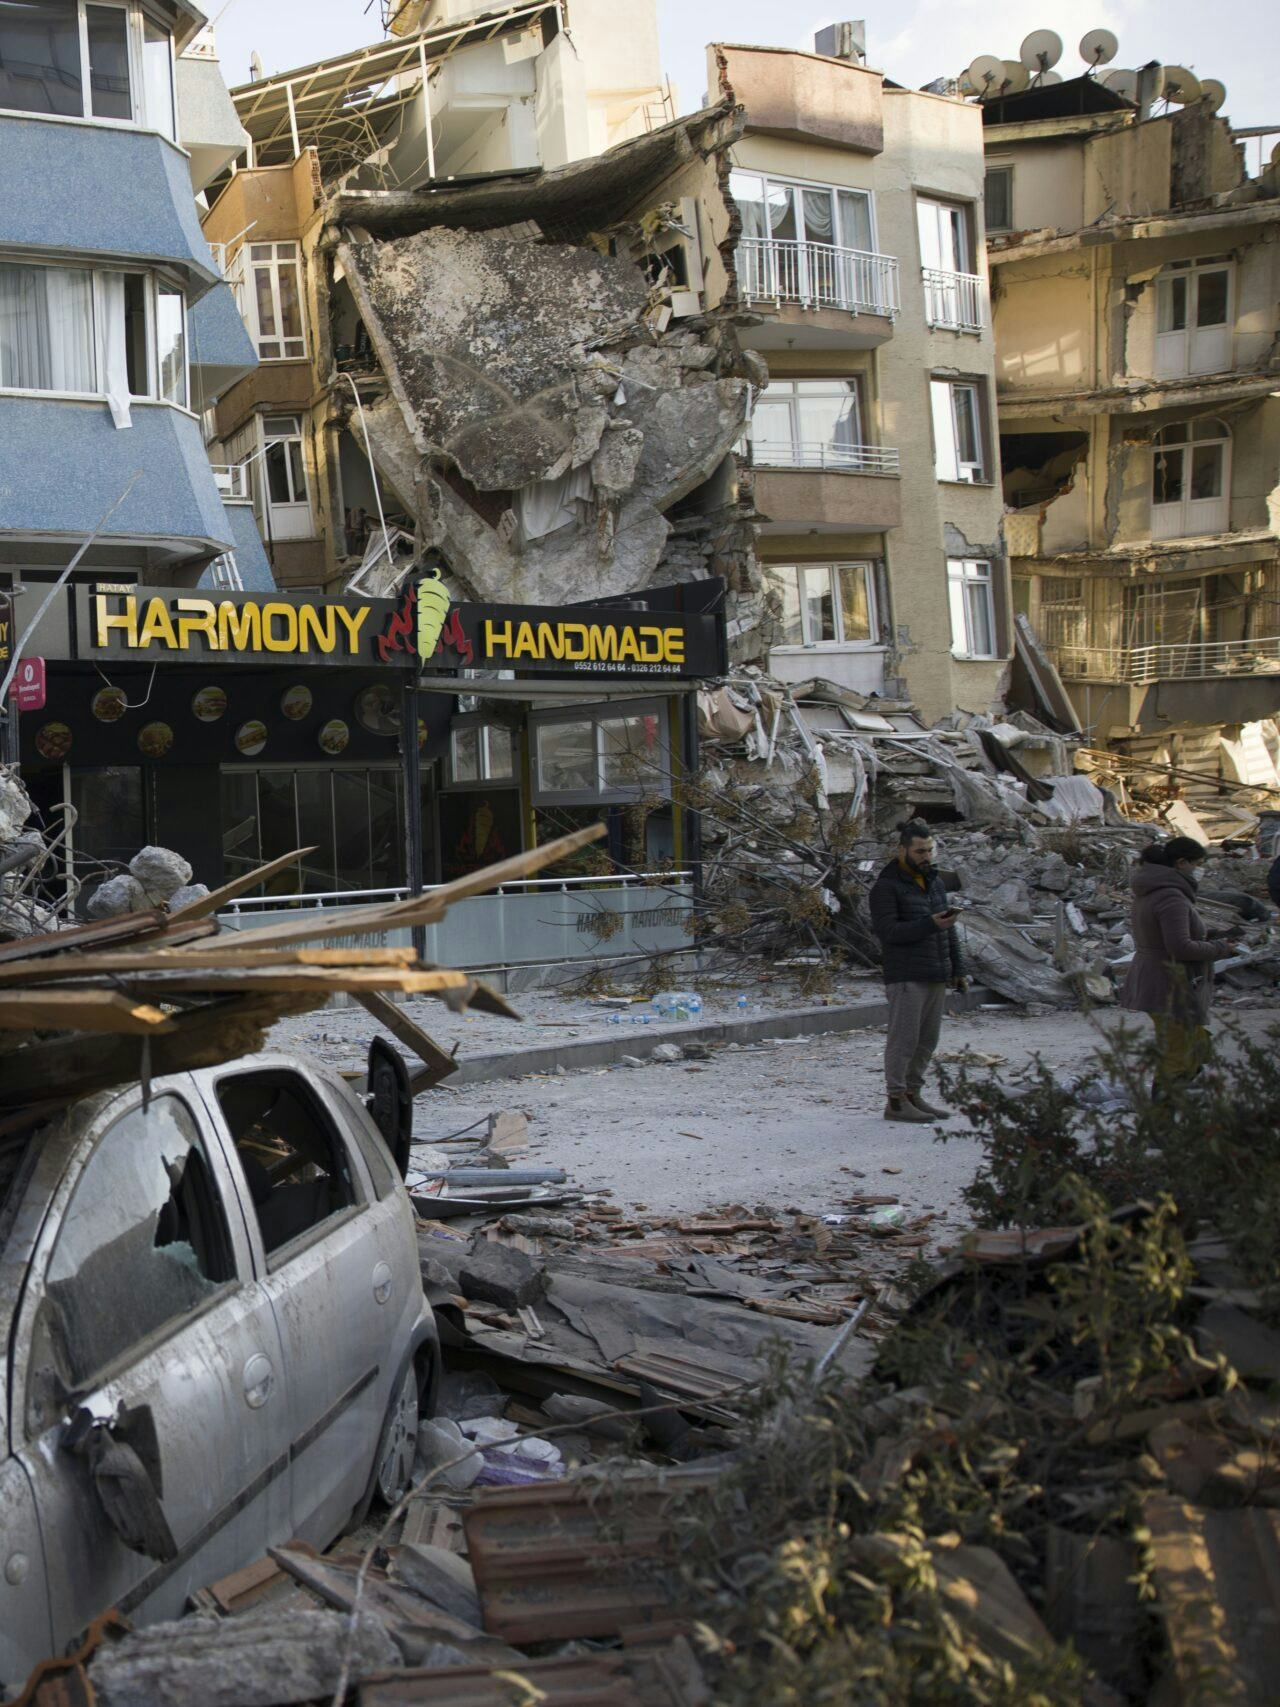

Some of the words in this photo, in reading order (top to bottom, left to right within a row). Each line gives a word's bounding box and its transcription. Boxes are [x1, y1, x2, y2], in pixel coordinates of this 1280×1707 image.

[99, 583, 132, 592] HATAY
[96, 594, 370, 654] HARMONY
[485, 619, 685, 663] HANDMADE
[574, 661, 592, 670] 0552
[593, 662, 606, 671] 612
[607, 663, 616, 671] 64
[617, 663, 626, 672] 64
[649, 664, 660, 672] 212
[662, 664, 671, 672] 64
[672, 664, 681, 672] 64
